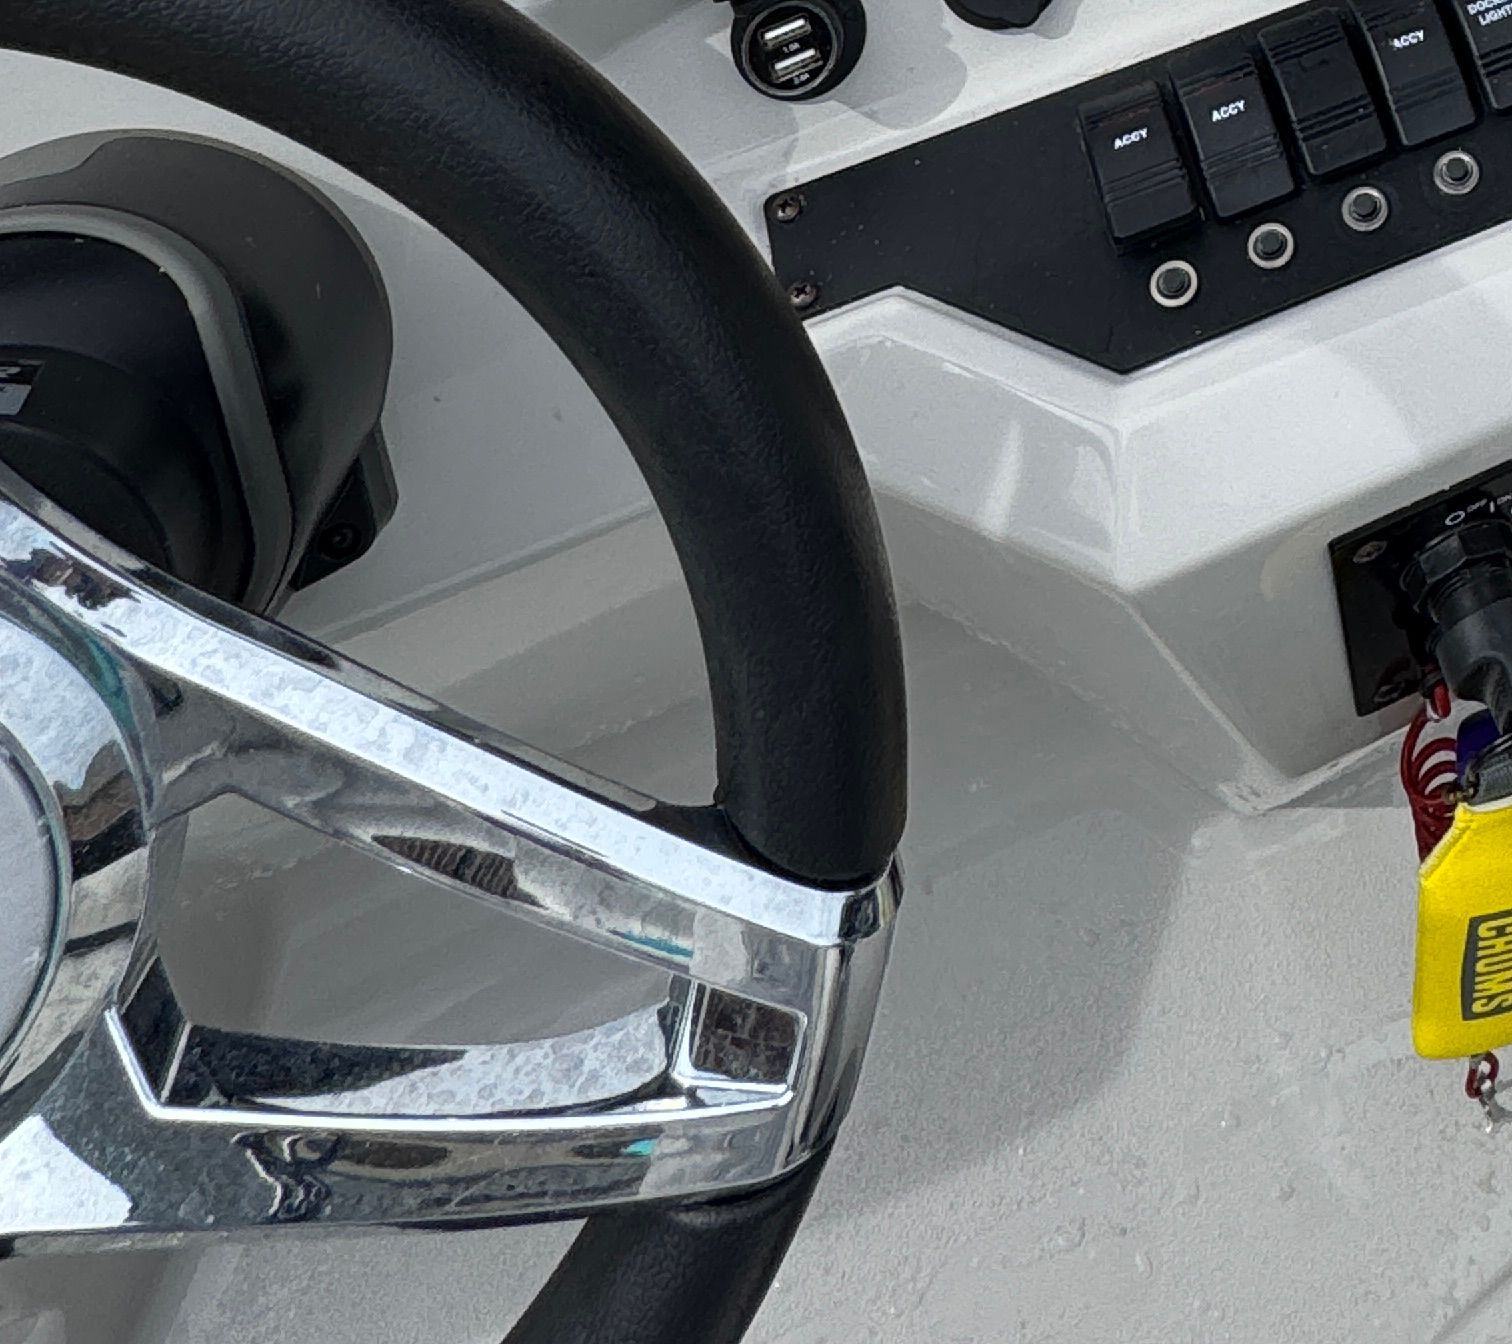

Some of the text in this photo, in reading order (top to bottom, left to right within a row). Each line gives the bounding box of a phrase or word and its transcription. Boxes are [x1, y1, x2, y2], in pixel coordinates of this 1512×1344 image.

[1391, 29, 1424, 50] ACCY
[1211, 99, 1246, 122] ACCY
[1114, 127, 1148, 150] ACCY
